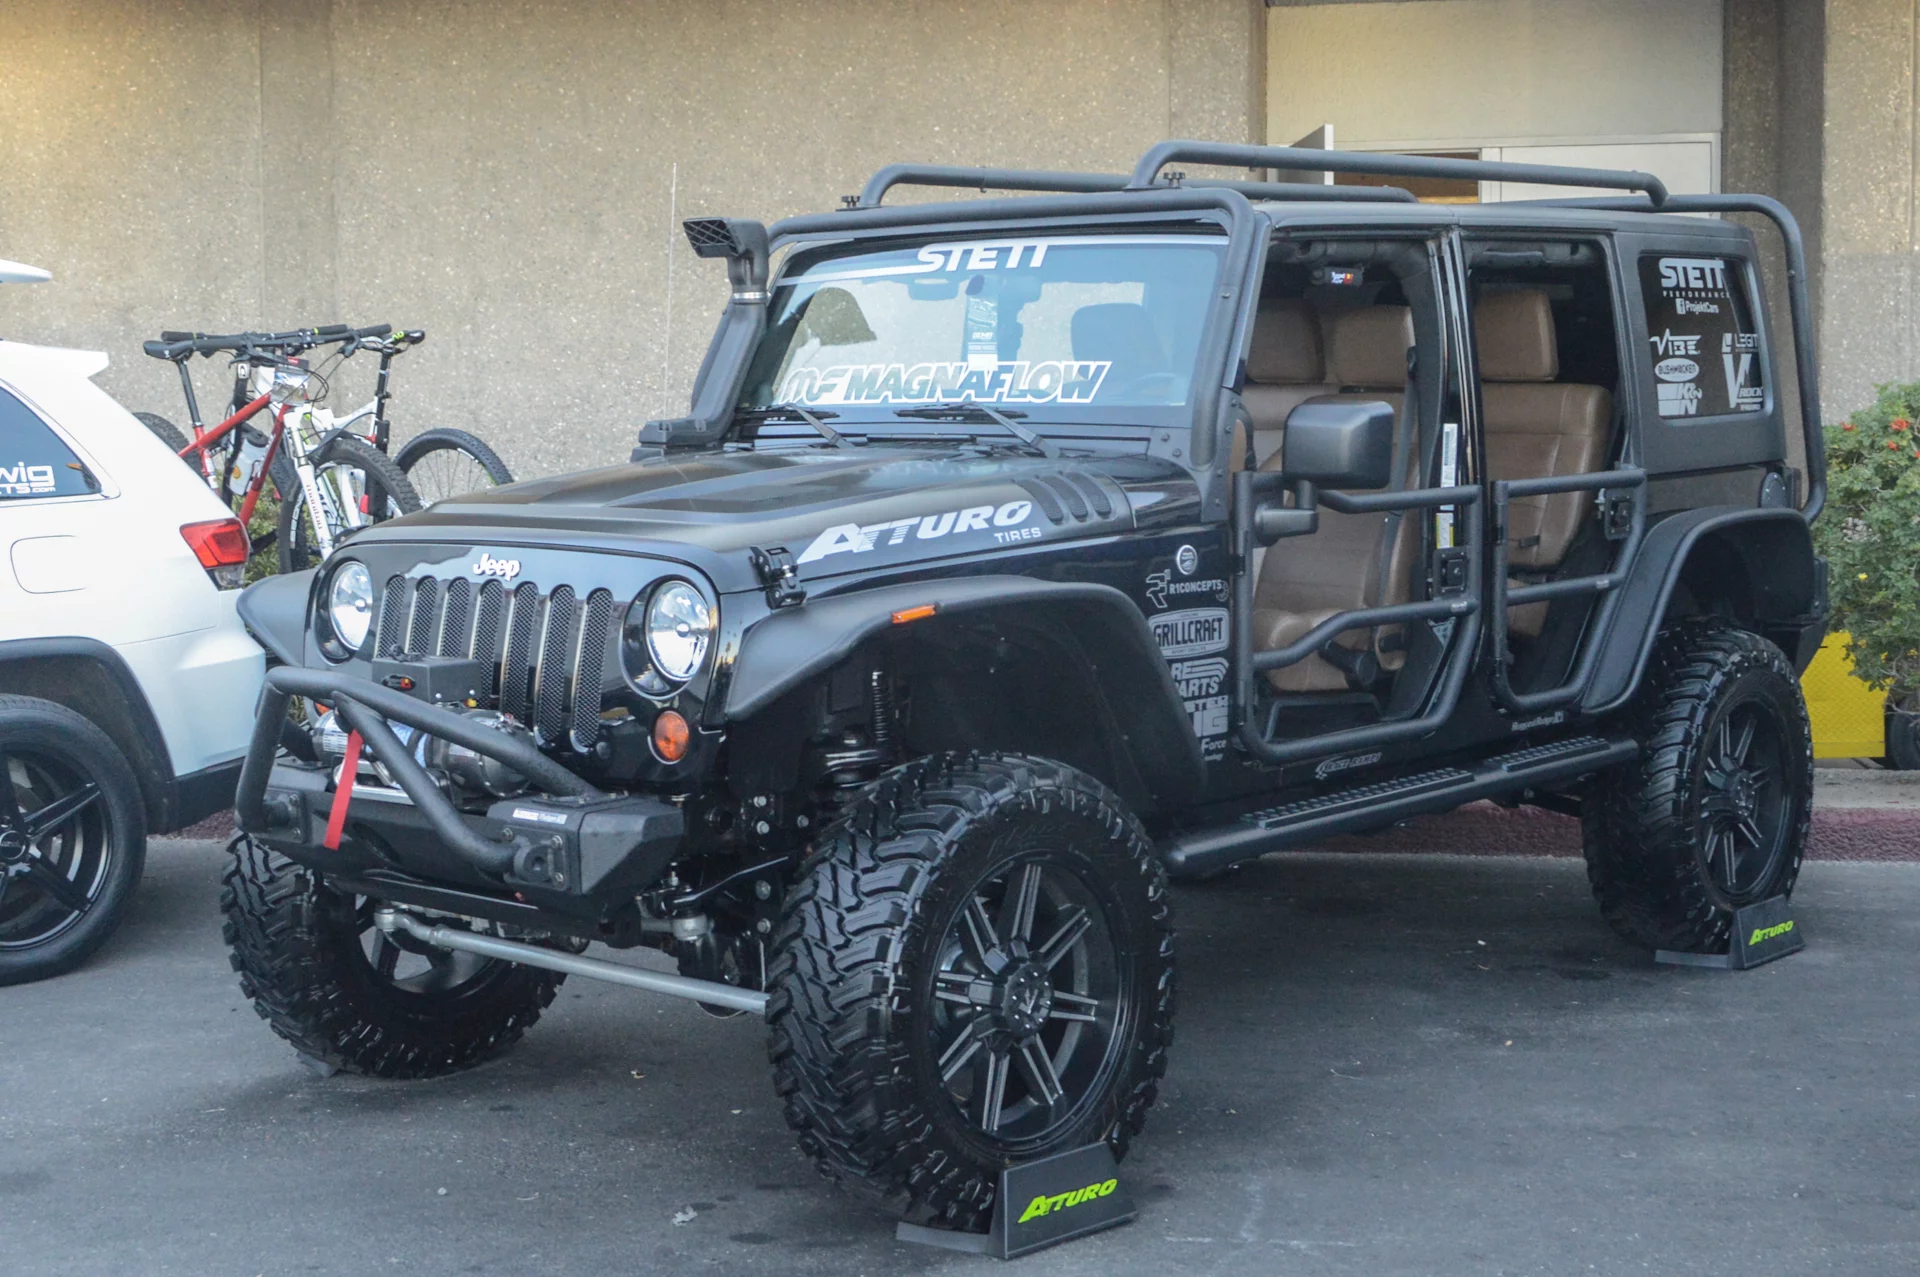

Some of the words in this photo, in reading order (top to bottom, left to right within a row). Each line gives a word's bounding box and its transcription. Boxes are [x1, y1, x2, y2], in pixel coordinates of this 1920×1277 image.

[917, 239, 1048, 273] STETT
[1658, 257, 1725, 289] STETT
[1649, 328, 1702, 356] VIBE
[842, 360, 1113, 405] MAGNAFLOW
[797, 500, 1033, 564] ATTURO
[994, 527, 1042, 544] TIRES
[472, 552, 521, 582] Jeep
[1153, 616, 1223, 647] GRILLCRAFT
[1018, 1178, 1118, 1224] ATTURO
